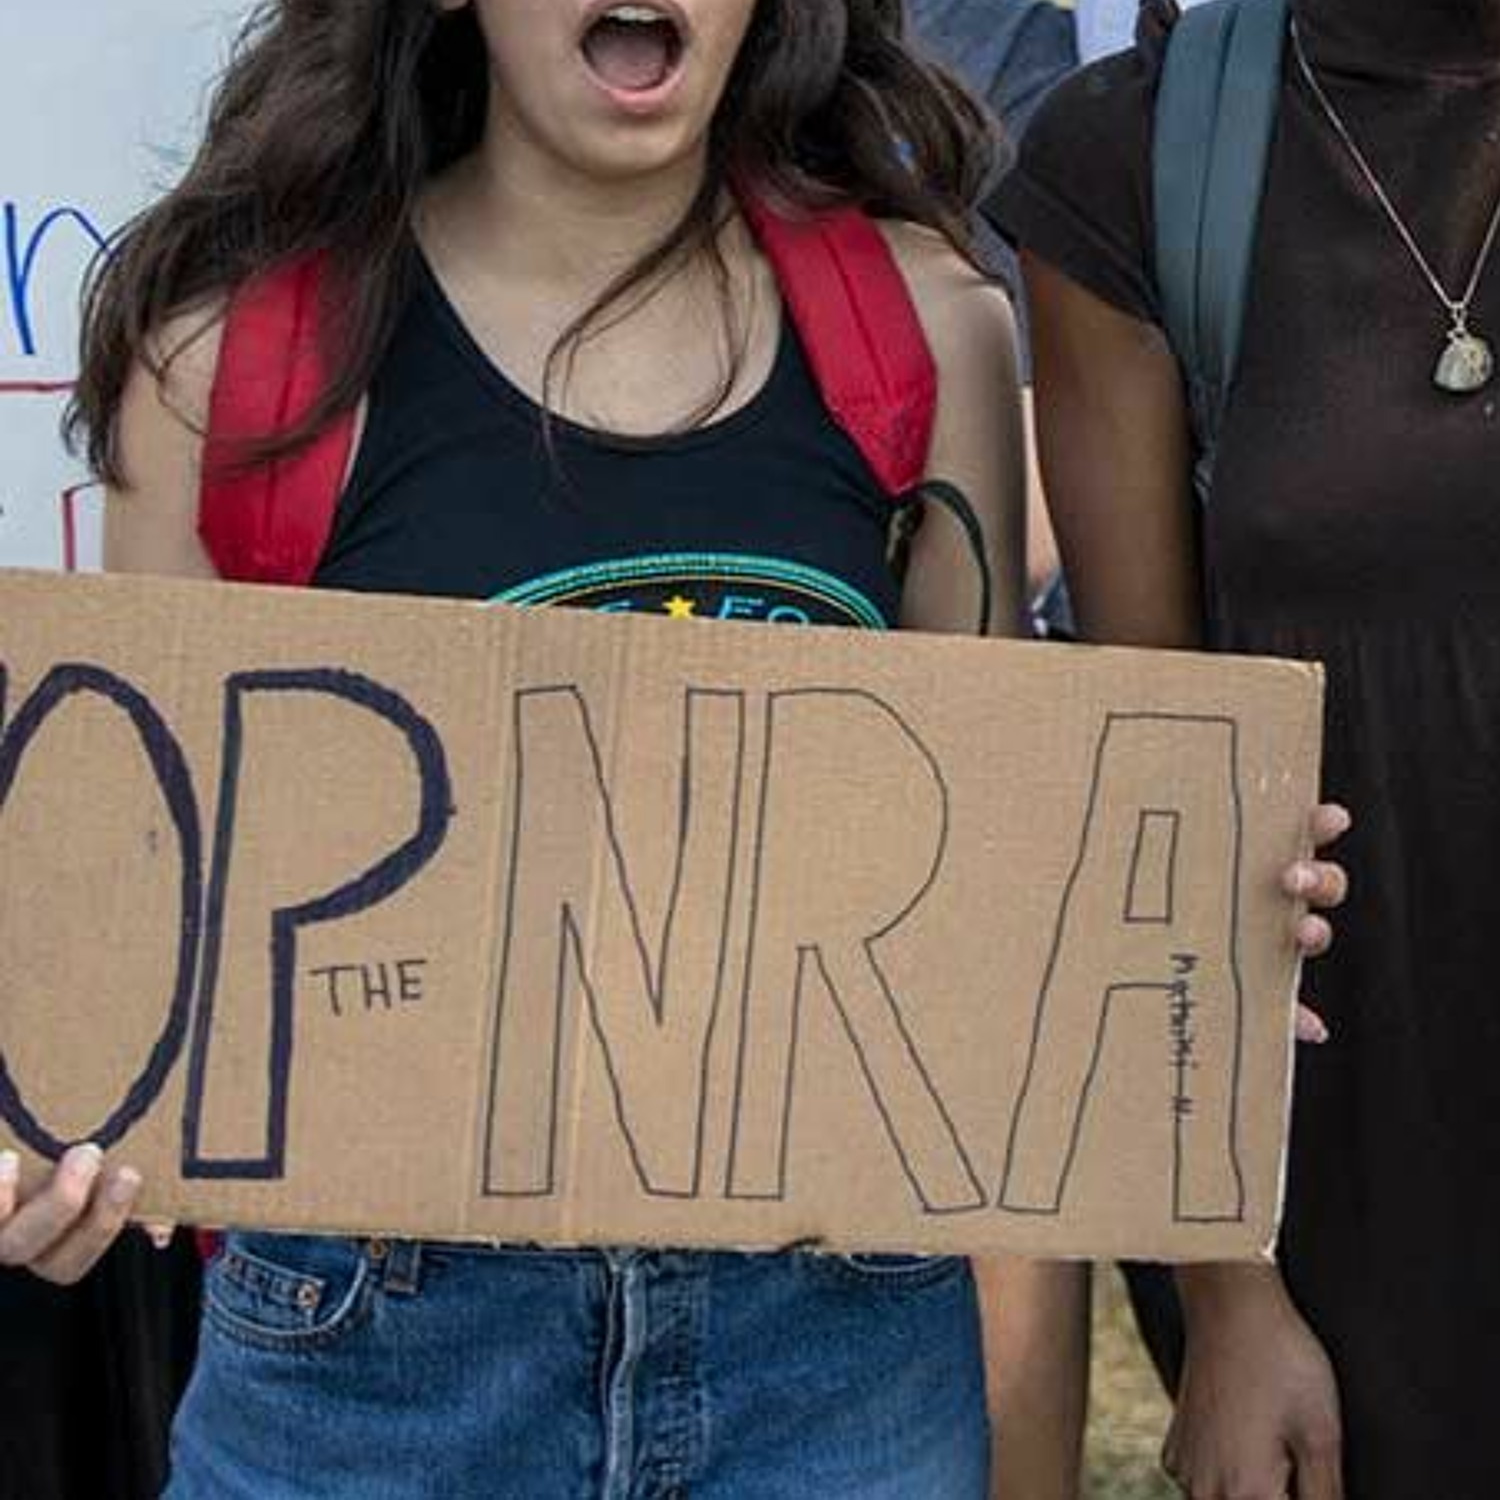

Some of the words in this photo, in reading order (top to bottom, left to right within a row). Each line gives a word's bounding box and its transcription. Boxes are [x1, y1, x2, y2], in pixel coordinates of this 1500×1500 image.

[0, 661, 456, 1180] OP
[309, 957, 428, 1020] THE
[482, 683, 1248, 1224] NRA
